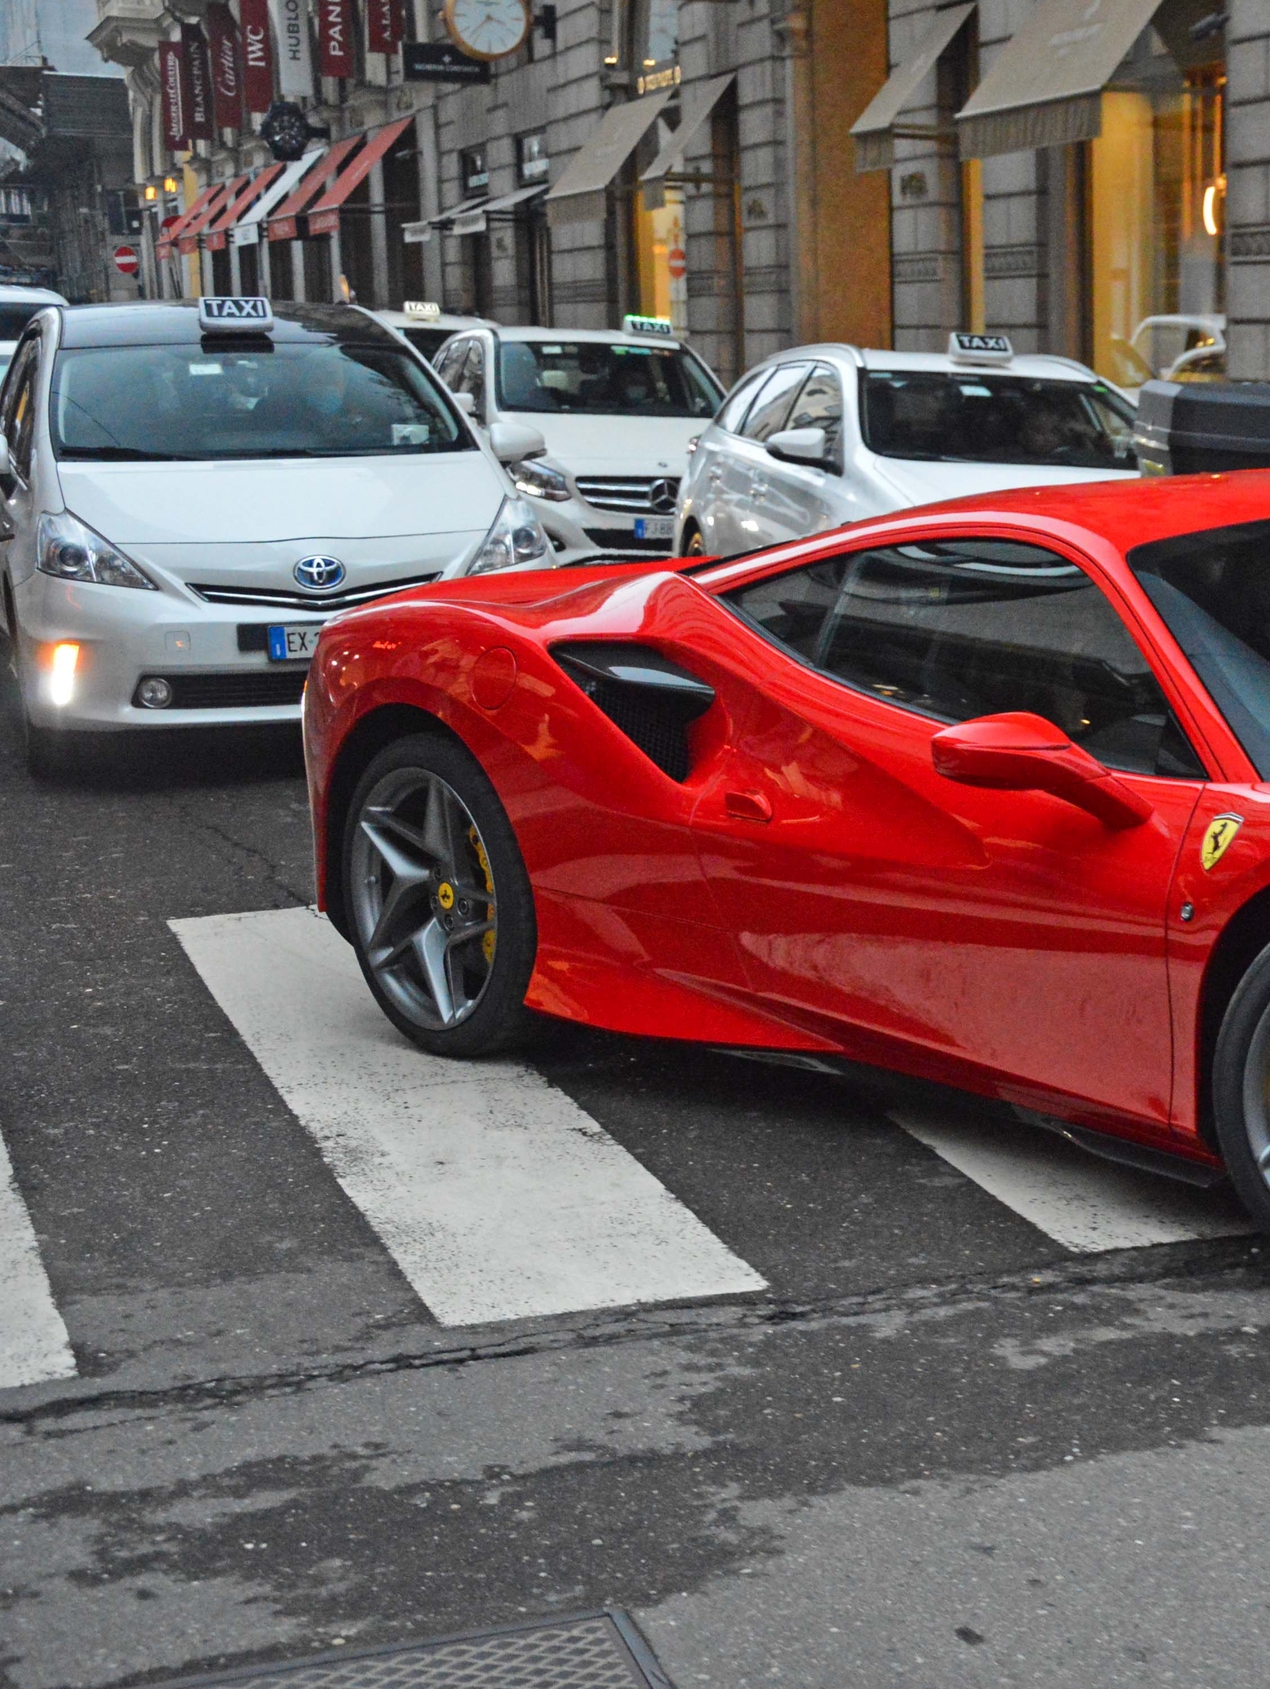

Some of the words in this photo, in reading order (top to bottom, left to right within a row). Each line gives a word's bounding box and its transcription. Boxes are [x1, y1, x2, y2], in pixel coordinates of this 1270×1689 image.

[327, 0, 344, 55] PAN
[246, 25, 265, 67] IWC
[189, 41, 205, 121] BLANCPAIN
[218, 36, 236, 97] Cartier
[205, 300, 264, 316] TAXI
[406, 302, 438, 312] TAXI
[631, 320, 669, 333] TAXI
[959, 336, 1005, 349] TAXI
